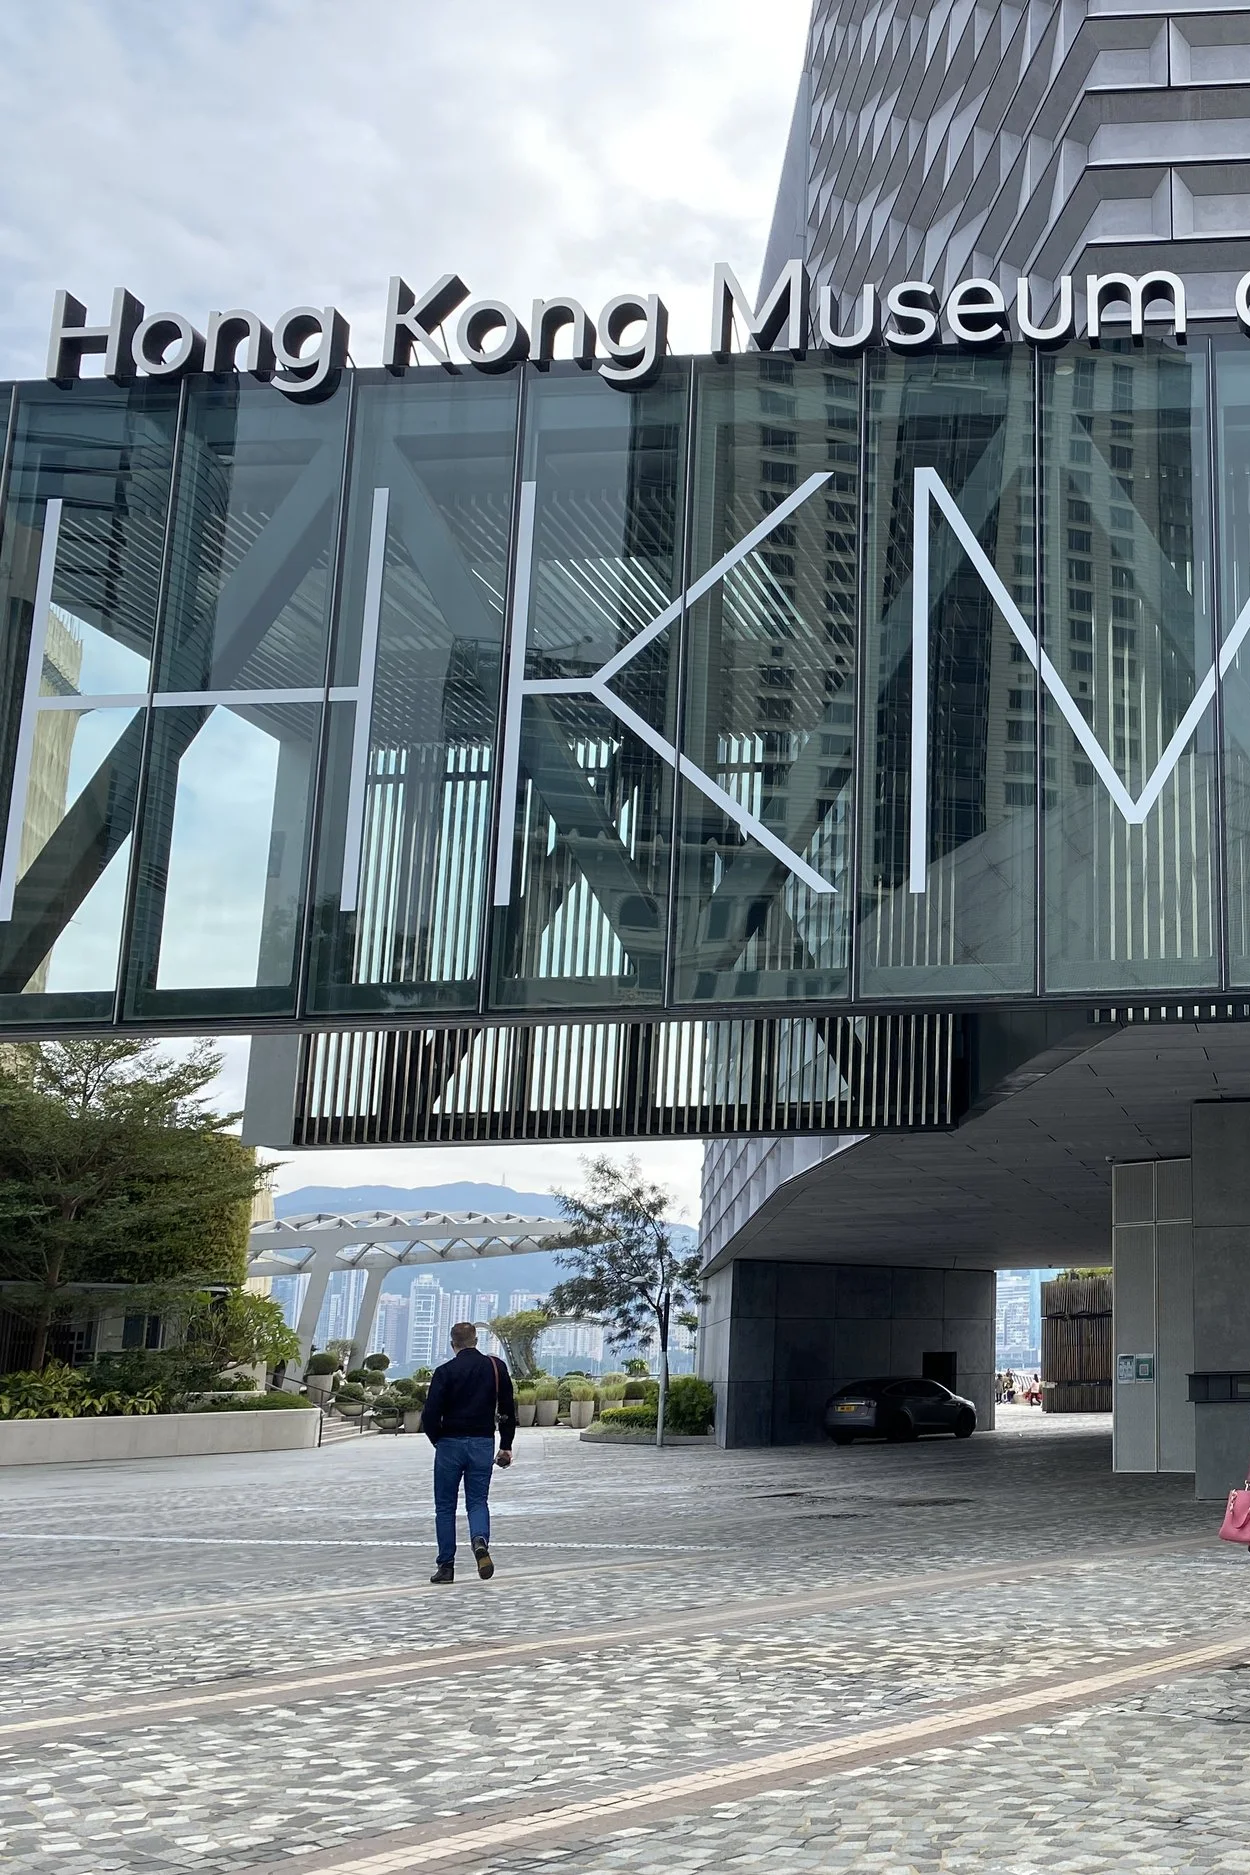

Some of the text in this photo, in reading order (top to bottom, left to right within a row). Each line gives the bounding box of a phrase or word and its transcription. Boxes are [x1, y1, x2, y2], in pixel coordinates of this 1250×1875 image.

[46, 286, 342, 397] Hong
[382, 273, 664, 384] Kong
[710, 259, 1190, 357] Museum
